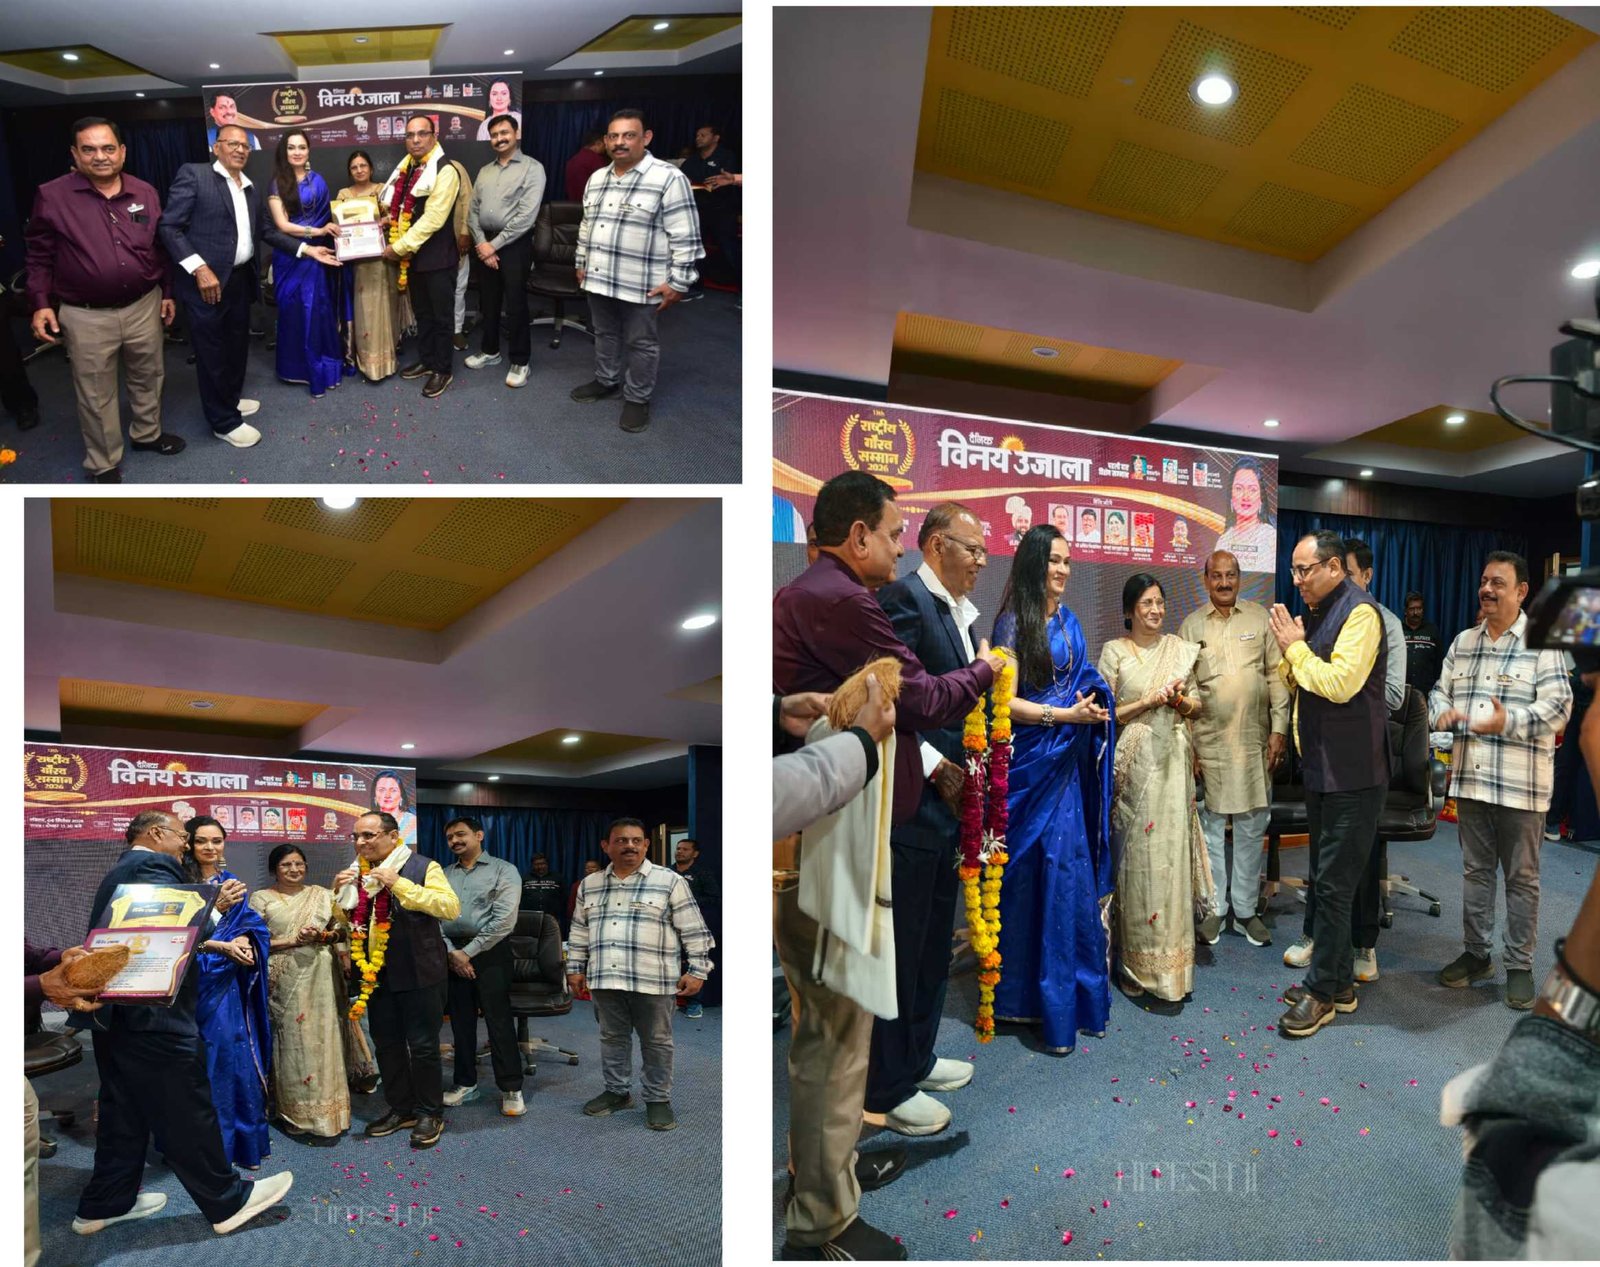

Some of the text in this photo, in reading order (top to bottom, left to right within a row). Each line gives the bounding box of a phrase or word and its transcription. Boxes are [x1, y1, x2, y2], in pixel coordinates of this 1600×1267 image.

[317, 88, 355, 107] विनय
[357, 92, 401, 105] उजाला
[860, 419, 897, 435] राष्ट्रीय
[864, 434, 893, 451] गौरव
[968, 432, 994, 445] दैनिक
[858, 450, 899, 465] सम्मान
[938, 428, 1093, 482] विनय उजाला
[36, 754, 70, 765] राष्ट्रीय
[40, 764, 67, 775] गौरव
[108, 758, 249, 790] विनय उजाला
[35, 775, 72, 784] सम्मान
